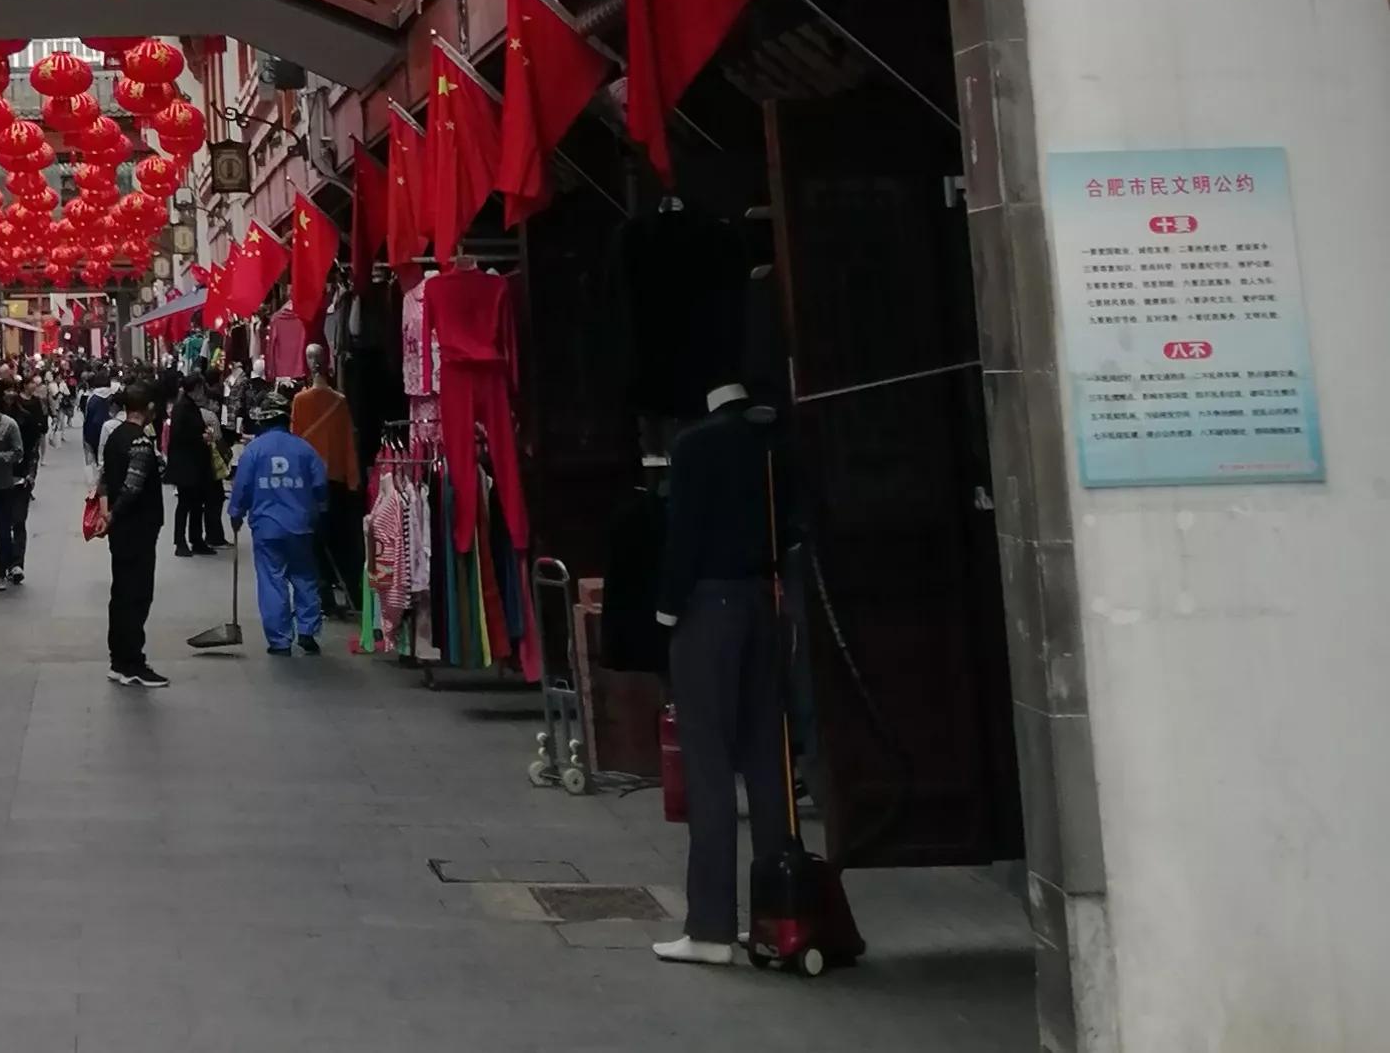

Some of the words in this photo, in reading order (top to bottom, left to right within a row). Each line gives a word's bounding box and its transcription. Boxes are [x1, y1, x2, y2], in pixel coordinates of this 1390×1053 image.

[1085, 173, 1255, 198] 合肥市民文明公约
[1155, 216, 1192, 233] 十要
[1170, 343, 1207, 359] 八不
